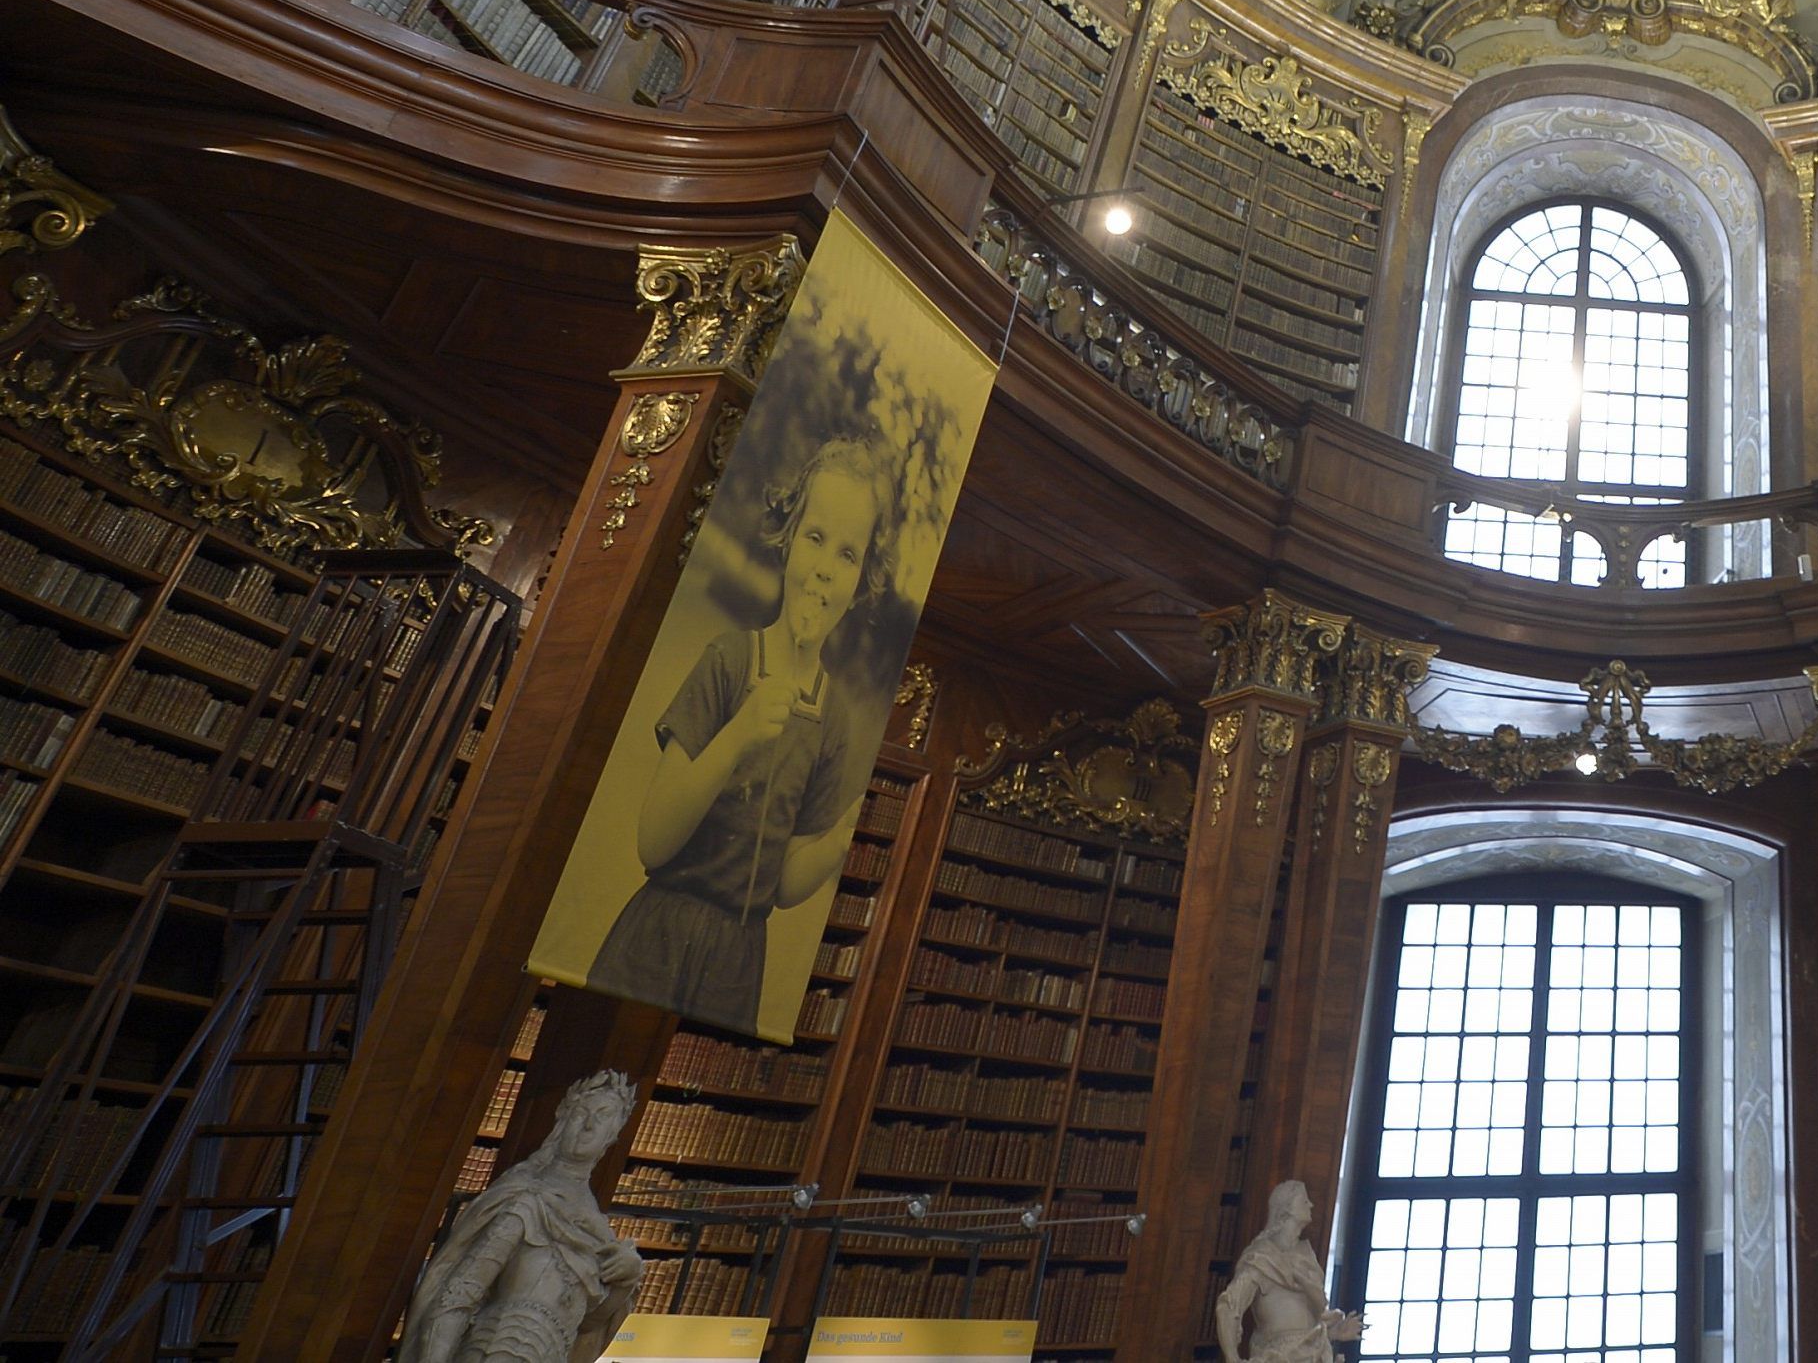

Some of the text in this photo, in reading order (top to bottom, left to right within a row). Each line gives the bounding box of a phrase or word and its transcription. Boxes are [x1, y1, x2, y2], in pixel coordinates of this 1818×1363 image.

[816, 1330, 904, 1345] Das gesunde Kind
